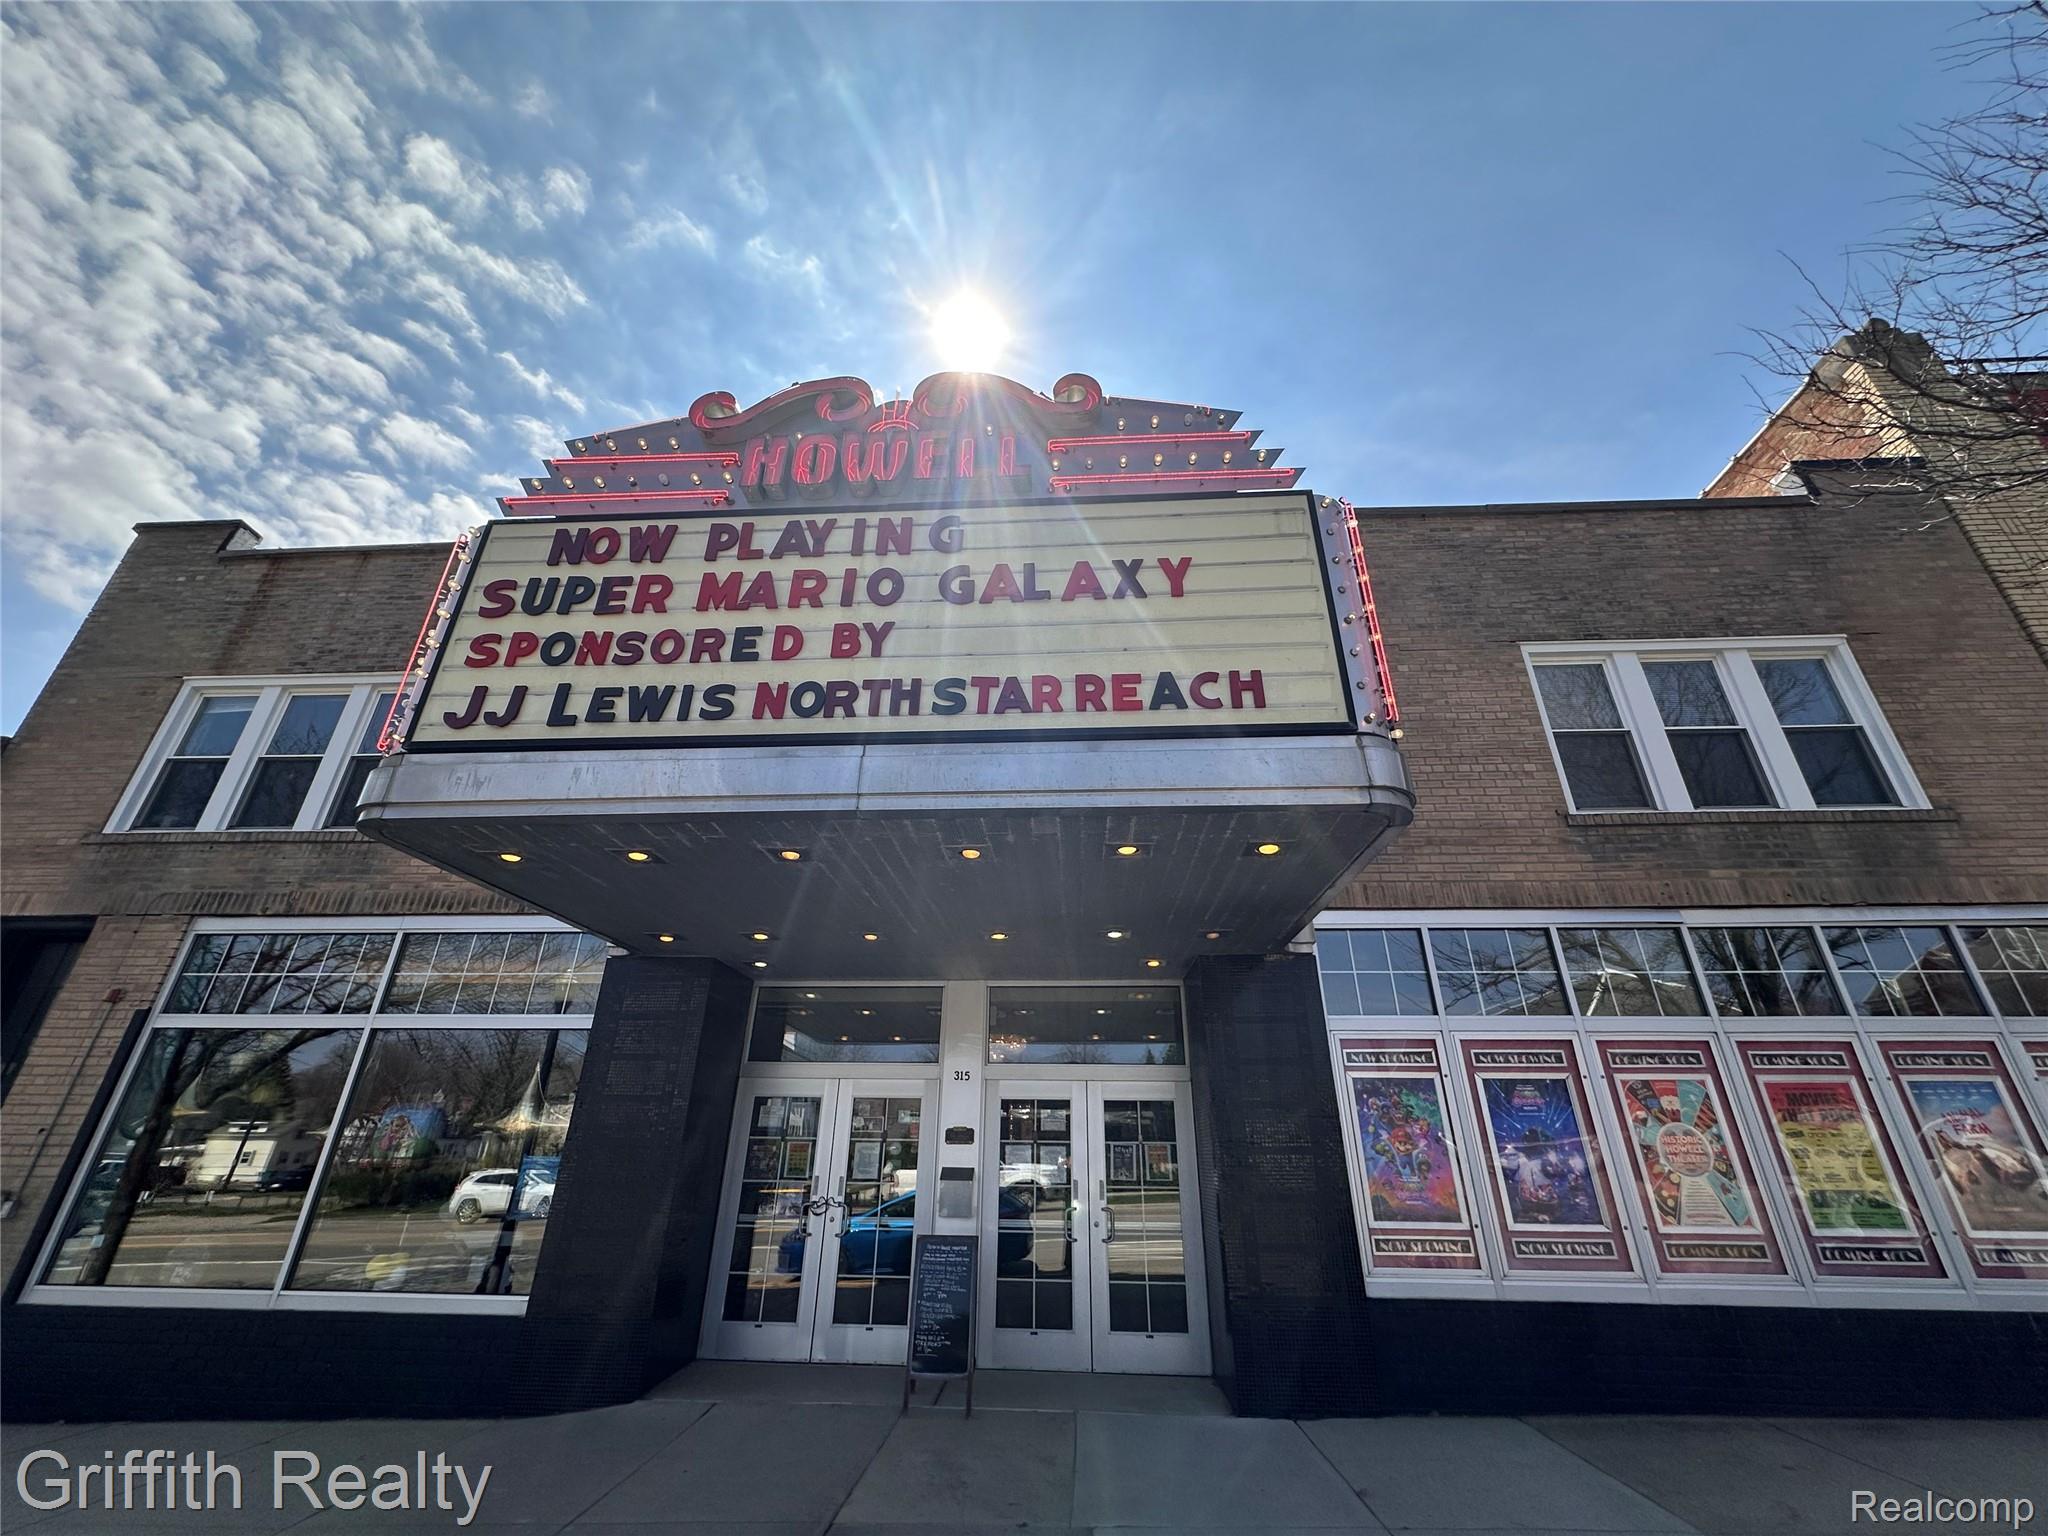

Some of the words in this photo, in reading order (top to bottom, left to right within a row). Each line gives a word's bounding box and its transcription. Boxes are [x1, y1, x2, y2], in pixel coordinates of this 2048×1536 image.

[740, 432, 1032, 492] HOWELL
[546, 524, 679, 566] NOW
[478, 574, 674, 618] SUPER
[695, 566, 905, 613] MARIO
[938, 556, 1193, 606] GALAXY
[463, 623, 805, 668] SPONSORED
[829, 620, 896, 660] BY
[442, 684, 528, 730] JJ
[545, 683, 737, 727] LEWIS
[953, 1070, 971, 1081] 315
